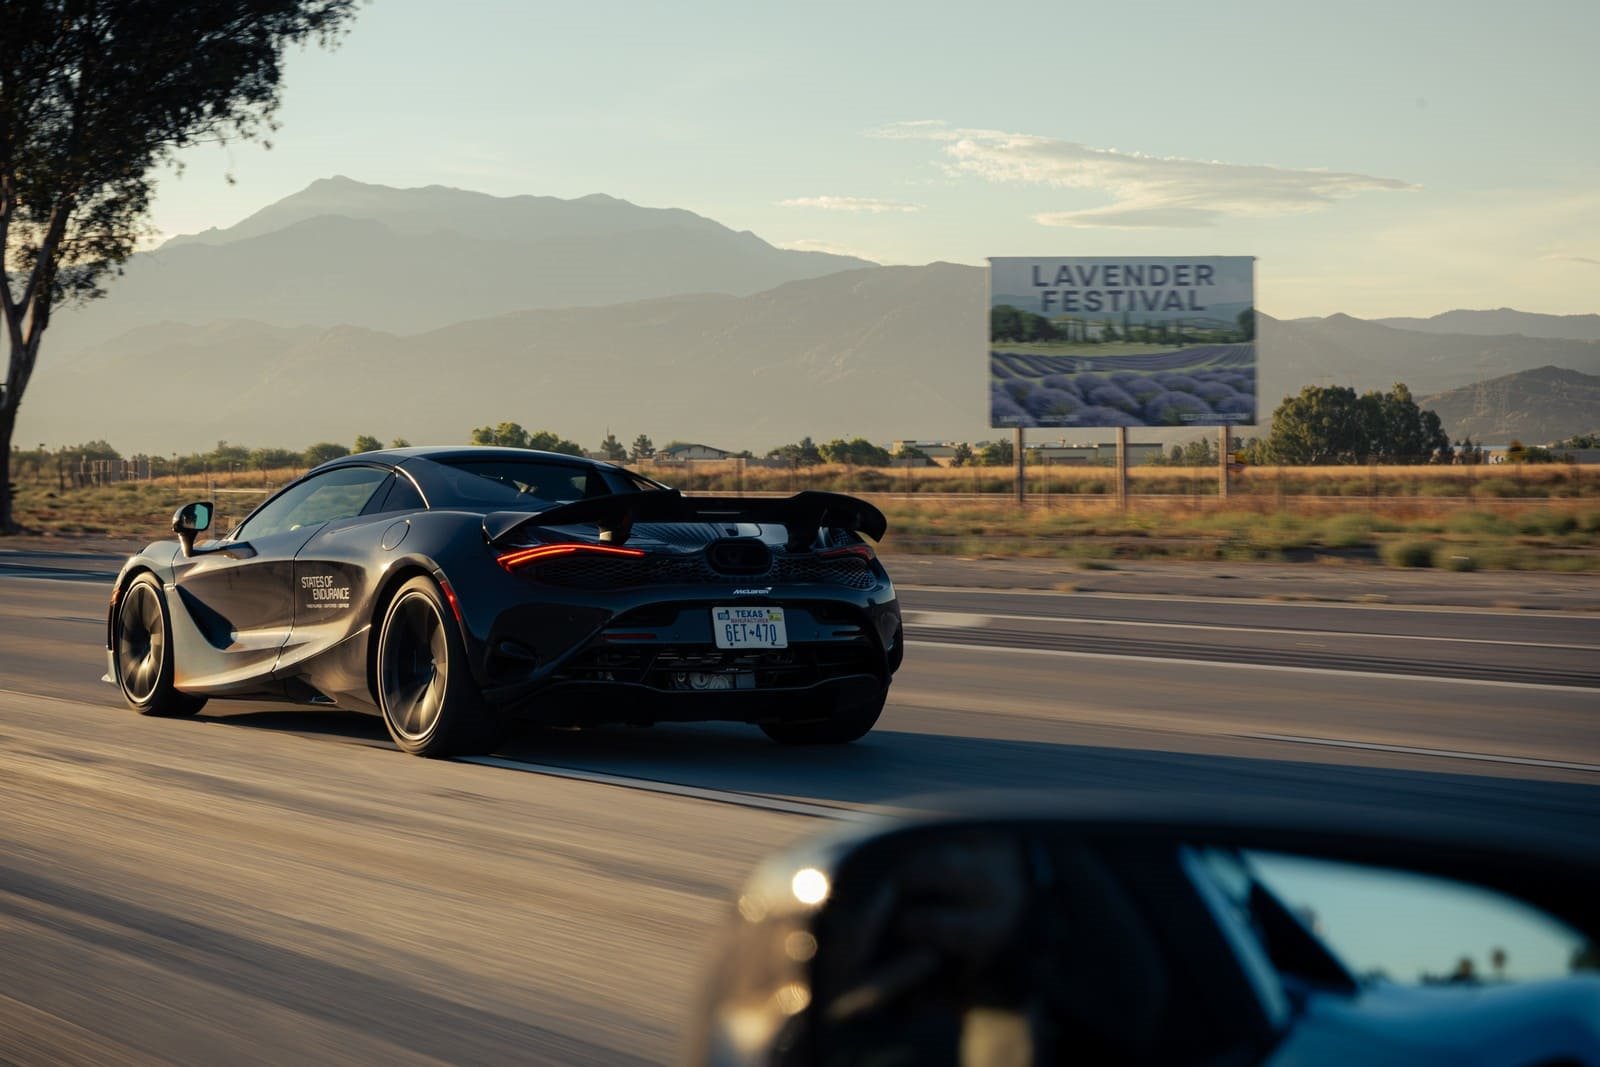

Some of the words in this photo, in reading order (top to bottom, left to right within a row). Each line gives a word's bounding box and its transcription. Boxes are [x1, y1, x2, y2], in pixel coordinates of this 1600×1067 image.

[1031, 264, 1215, 287] LAVENDER
[1041, 290, 1206, 312] FESTIVAL
[301, 576, 324, 588] STATES
[325, 576, 333, 588] OF
[313, 587, 350, 600] ENDURANCE
[735, 610, 763, 618] TEXAS
